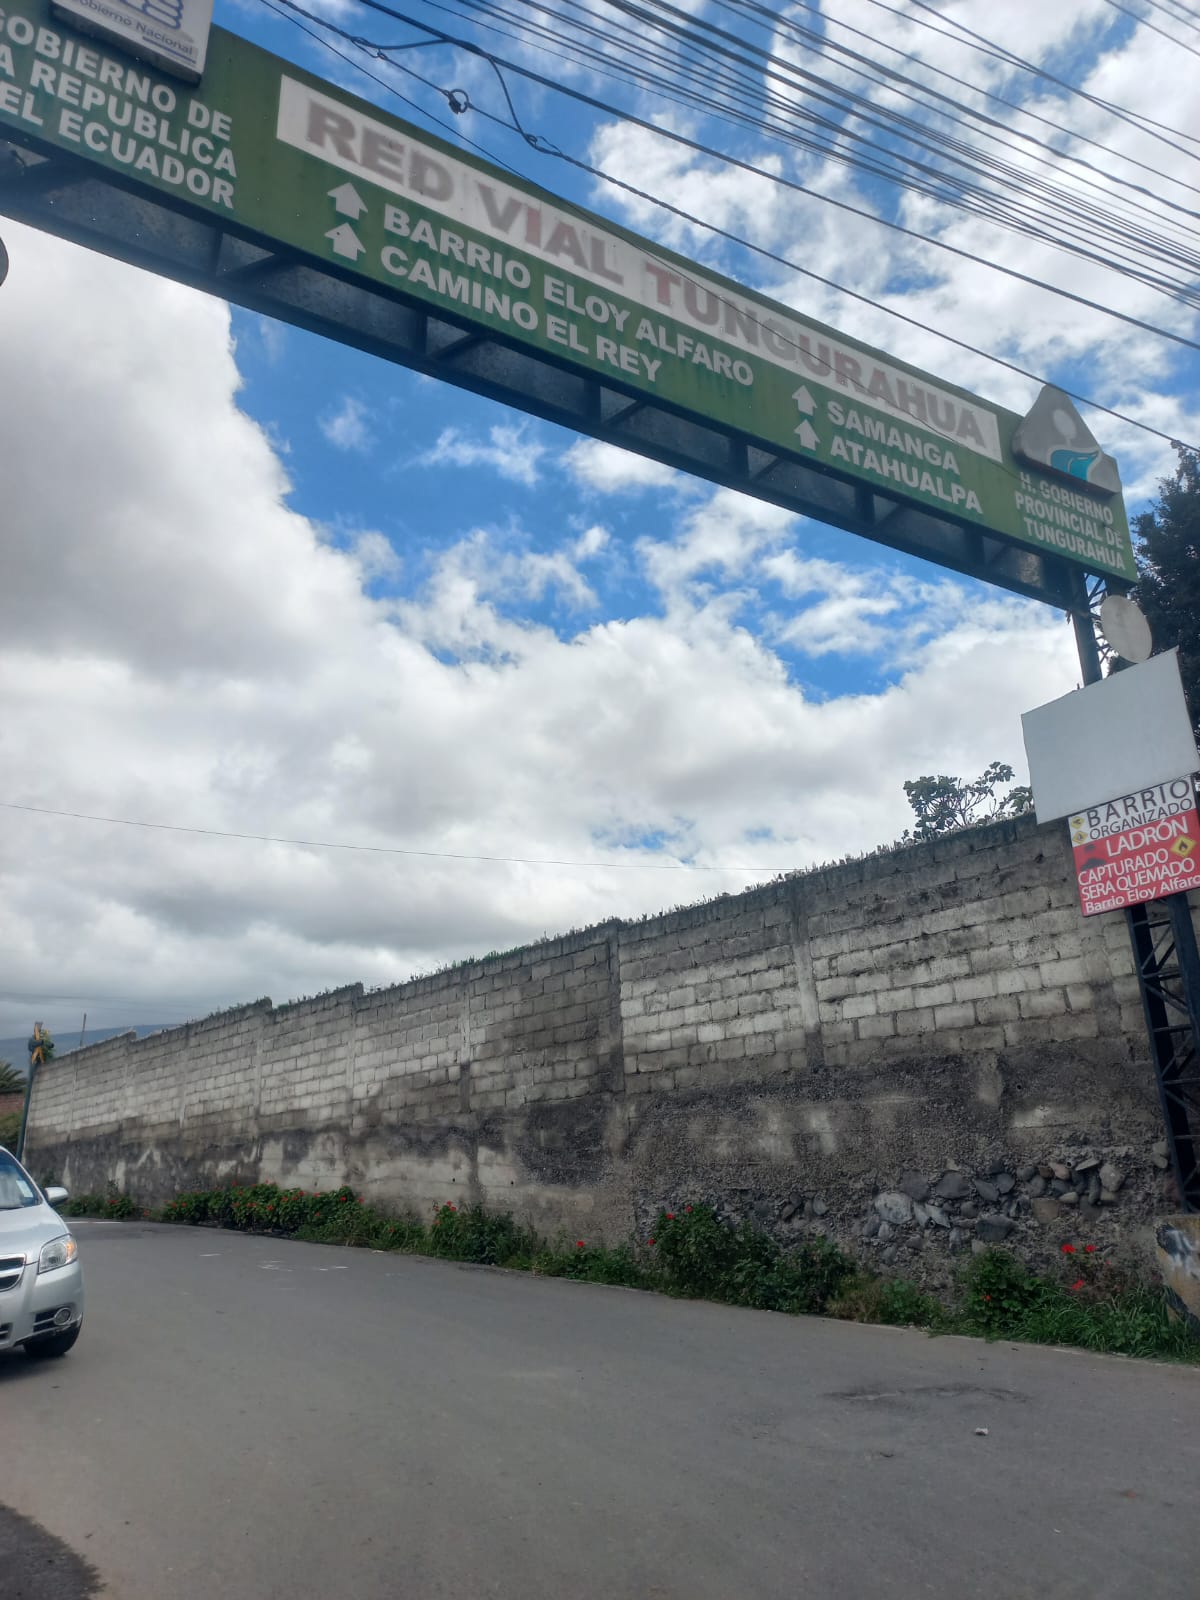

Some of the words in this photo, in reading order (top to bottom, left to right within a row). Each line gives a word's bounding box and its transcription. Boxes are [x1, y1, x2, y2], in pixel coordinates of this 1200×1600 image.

[80, 0, 132, 26] obierno
[136, 21, 193, 55] Nacional
[30, 59, 237, 177] REPUBLICA
[188, 99, 232, 141] DE
[58, 108, 234, 209] ECUADOR
[306, 100, 455, 202] RED
[477, 184, 624, 286] VIAL
[645, 261, 987, 448] TUNGURAHUA
[384, 204, 531, 289] BARRIO
[544, 274, 631, 331] ELOY
[635, 319, 754, 387] ALFARO
[380, 246, 538, 330] CAMINO
[546, 314, 589, 353] EL
[596, 335, 662, 383] REY
[827, 402, 961, 475] SAMANGA
[831, 436, 983, 514] ATAHUALPA
[1020, 471, 1036, 494] H.
[1040, 480, 1114, 526] GOBIERNO
[1015, 491, 1102, 541] PROVINCIAL
[1105, 527, 1124, 549] DE
[1024, 517, 1126, 571] TUNGURAHUA
[1086, 779, 1190, 828] BARRIO
[1089, 798, 1192, 840] ORGANIZADO
[1106, 816, 1189, 857] LADRÓN
[1078, 848, 1169, 886] CAPTURADO
[1116, 857, 1195, 891] QUEMADO
[1085, 894, 1125, 914] Barrio
[1127, 886, 1157, 903] Eloy
